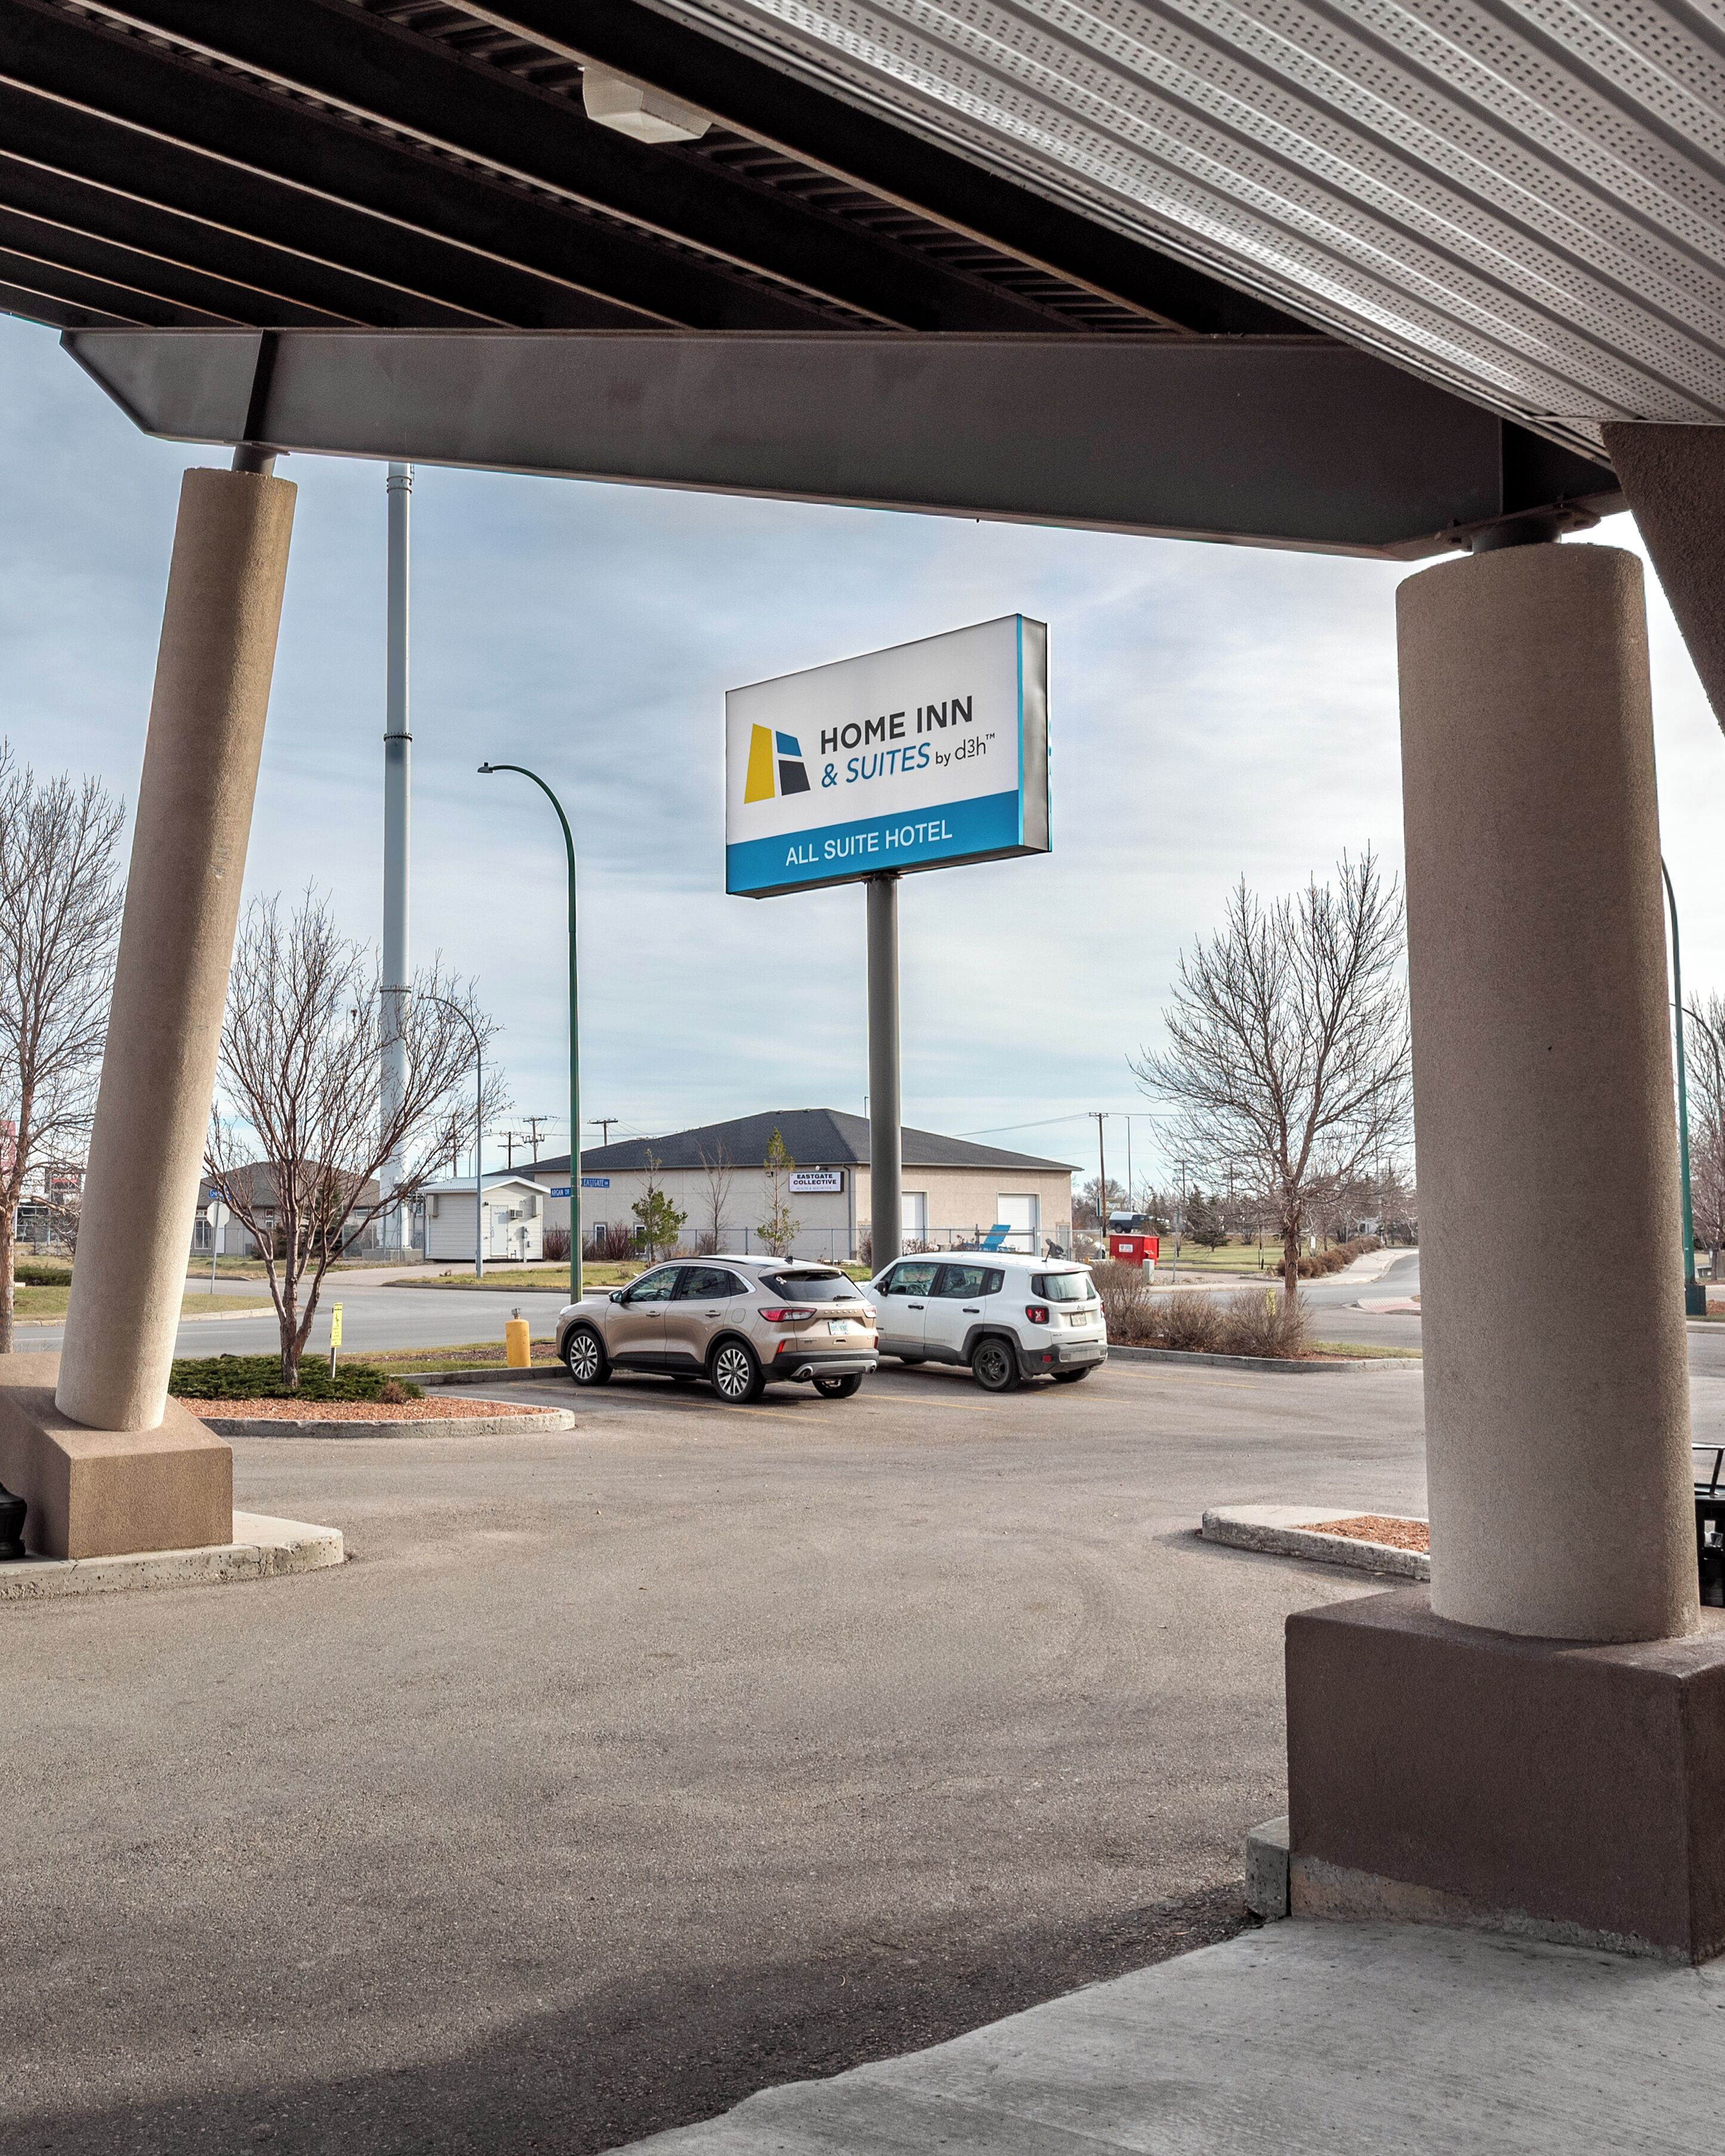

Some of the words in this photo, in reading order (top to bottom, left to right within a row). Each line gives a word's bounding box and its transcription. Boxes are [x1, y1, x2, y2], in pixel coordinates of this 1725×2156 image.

[821, 711, 905, 755] HOME
[917, 695, 972, 734] INN
[821, 763, 838, 788] &
[846, 742, 931, 783] SUITES
[935, 751, 951, 767] by
[785, 843, 819, 867] ALL
[824, 832, 879, 859] SUITE
[885, 819, 953, 849] HOTEL
